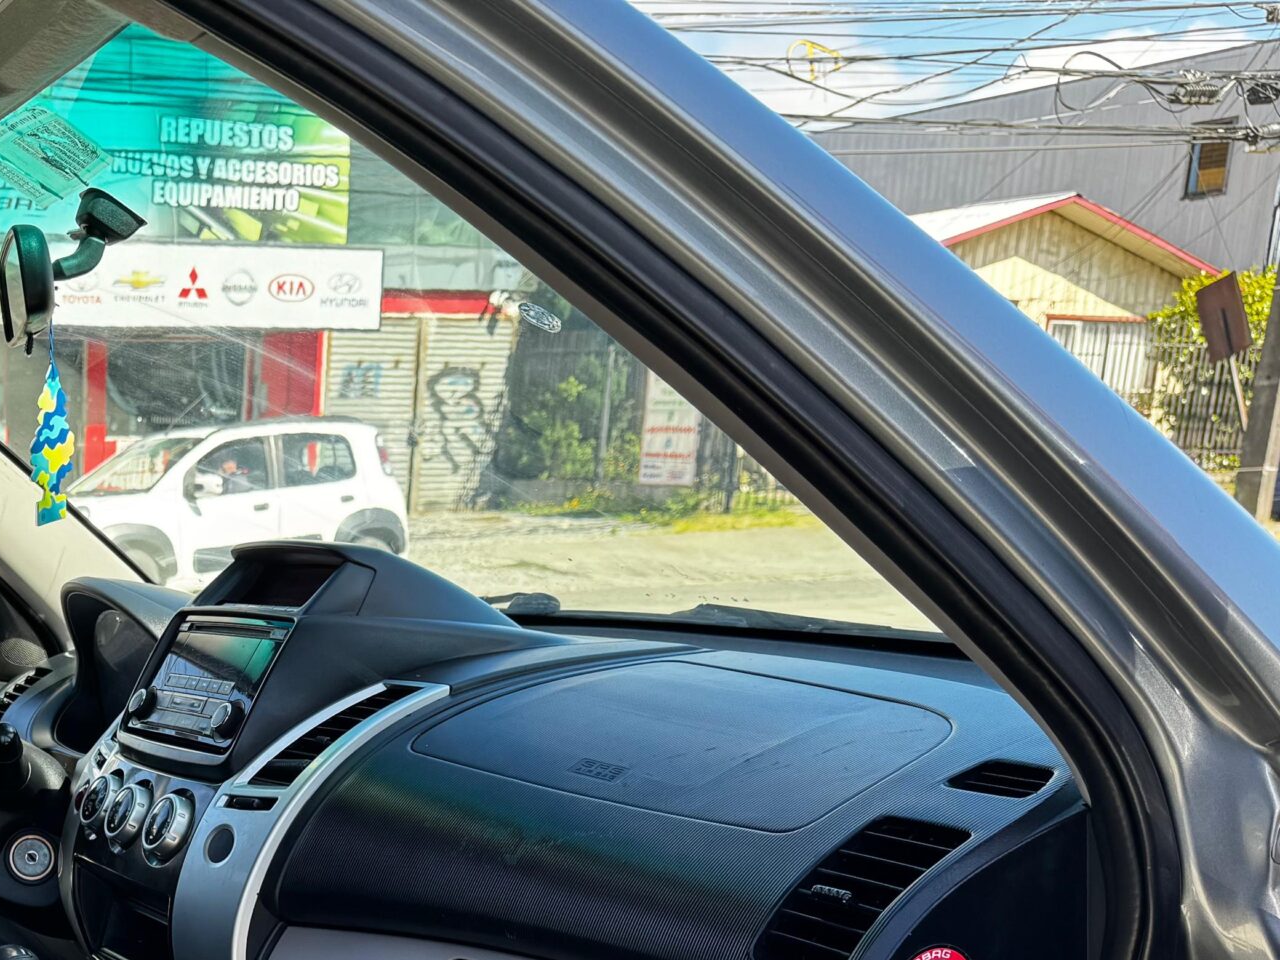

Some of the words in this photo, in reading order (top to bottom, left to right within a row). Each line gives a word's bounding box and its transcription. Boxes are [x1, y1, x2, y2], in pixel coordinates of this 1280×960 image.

[161, 117, 294, 150] REPUESTOS
[112, 151, 194, 179] NUEVOS
[195, 155, 211, 180] Y
[212, 157, 340, 188] ACCESORIOS
[152, 180, 300, 211] EQUIPAMIENTO
[276, 280, 307, 297] KIA
[62, 295, 102, 304] TOYOTA
[114, 295, 165, 303] CHEVROLET
[320, 298, 369, 308] HYUNDAI
